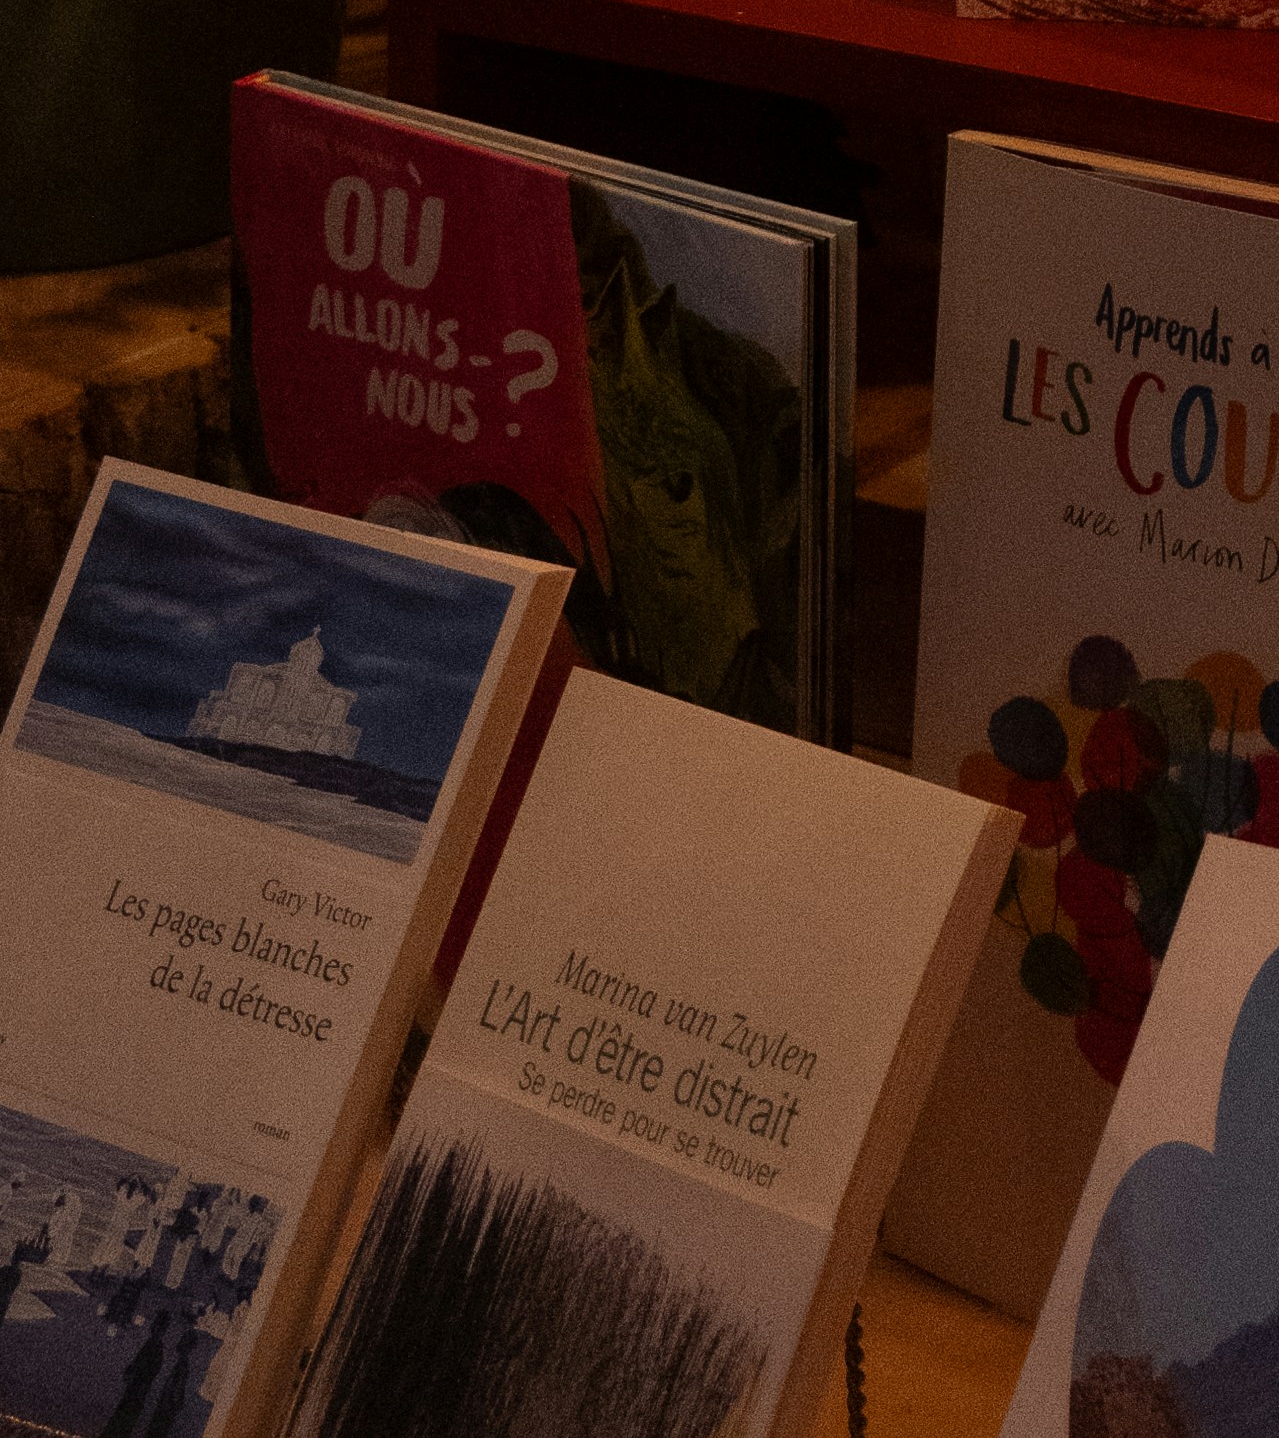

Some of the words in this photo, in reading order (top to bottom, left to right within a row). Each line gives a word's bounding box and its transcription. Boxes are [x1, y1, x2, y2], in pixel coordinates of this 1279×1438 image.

[322, 160, 446, 290] OÙ
[307, 284, 494, 373] ALLONS-
[1096, 283, 1233, 367] Apprends
[1252, 328, 1271, 370] à
[366, 367, 480, 444] NOUS
[1003, 338, 1092, 436] LES
[1062, 500, 1120, 538] avec
[1139, 508, 1245, 574] Marion
[103, 879, 147, 922] Les
[149, 903, 226, 948] pages
[231, 917, 353, 987] blanches
[261, 877, 305, 917] Gary
[313, 891, 373, 932] Victor
[150, 955, 183, 994] de
[188, 964, 211, 1004] la
[219, 977, 333, 1042] détresse
[555, 949, 659, 1020] Marina
[663, 1001, 718, 1043] van
[720, 1012, 820, 1081] Zuylen
[479, 978, 562, 1054] L'Art
[566, 1014, 666, 1095] d'être
[673, 1058, 799, 1149] distrait
[252, 1119, 292, 1142] roman
[518, 1060, 546, 1096] Se
[547, 1070, 617, 1126] perdre
[618, 1101, 671, 1148] pour
[672, 1124, 700, 1156] se
[702, 1134, 782, 1191] trouver
